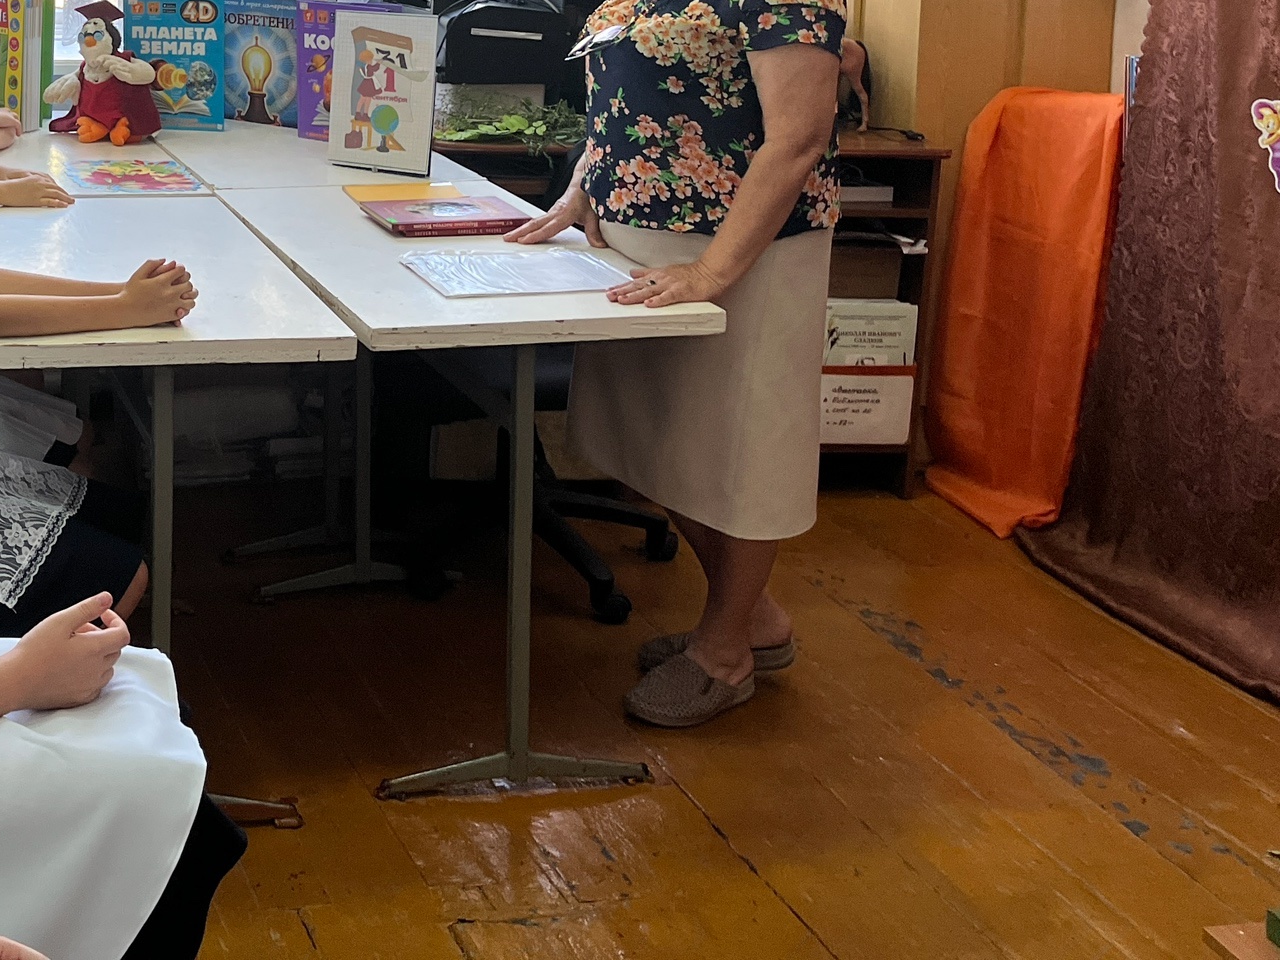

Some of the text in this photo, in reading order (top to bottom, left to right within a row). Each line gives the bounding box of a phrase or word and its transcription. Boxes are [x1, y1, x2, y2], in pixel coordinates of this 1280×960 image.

[182, 0, 216, 22] 4D
[224, 12, 296, 30] ЗОБРЕТЕНИ
[132, 26, 217, 40] ПЛАНЕТА
[140, 40, 206, 56] ЗЕМЛЯ
[375, 48, 407, 69] 31
[384, 67, 396, 92] 1
